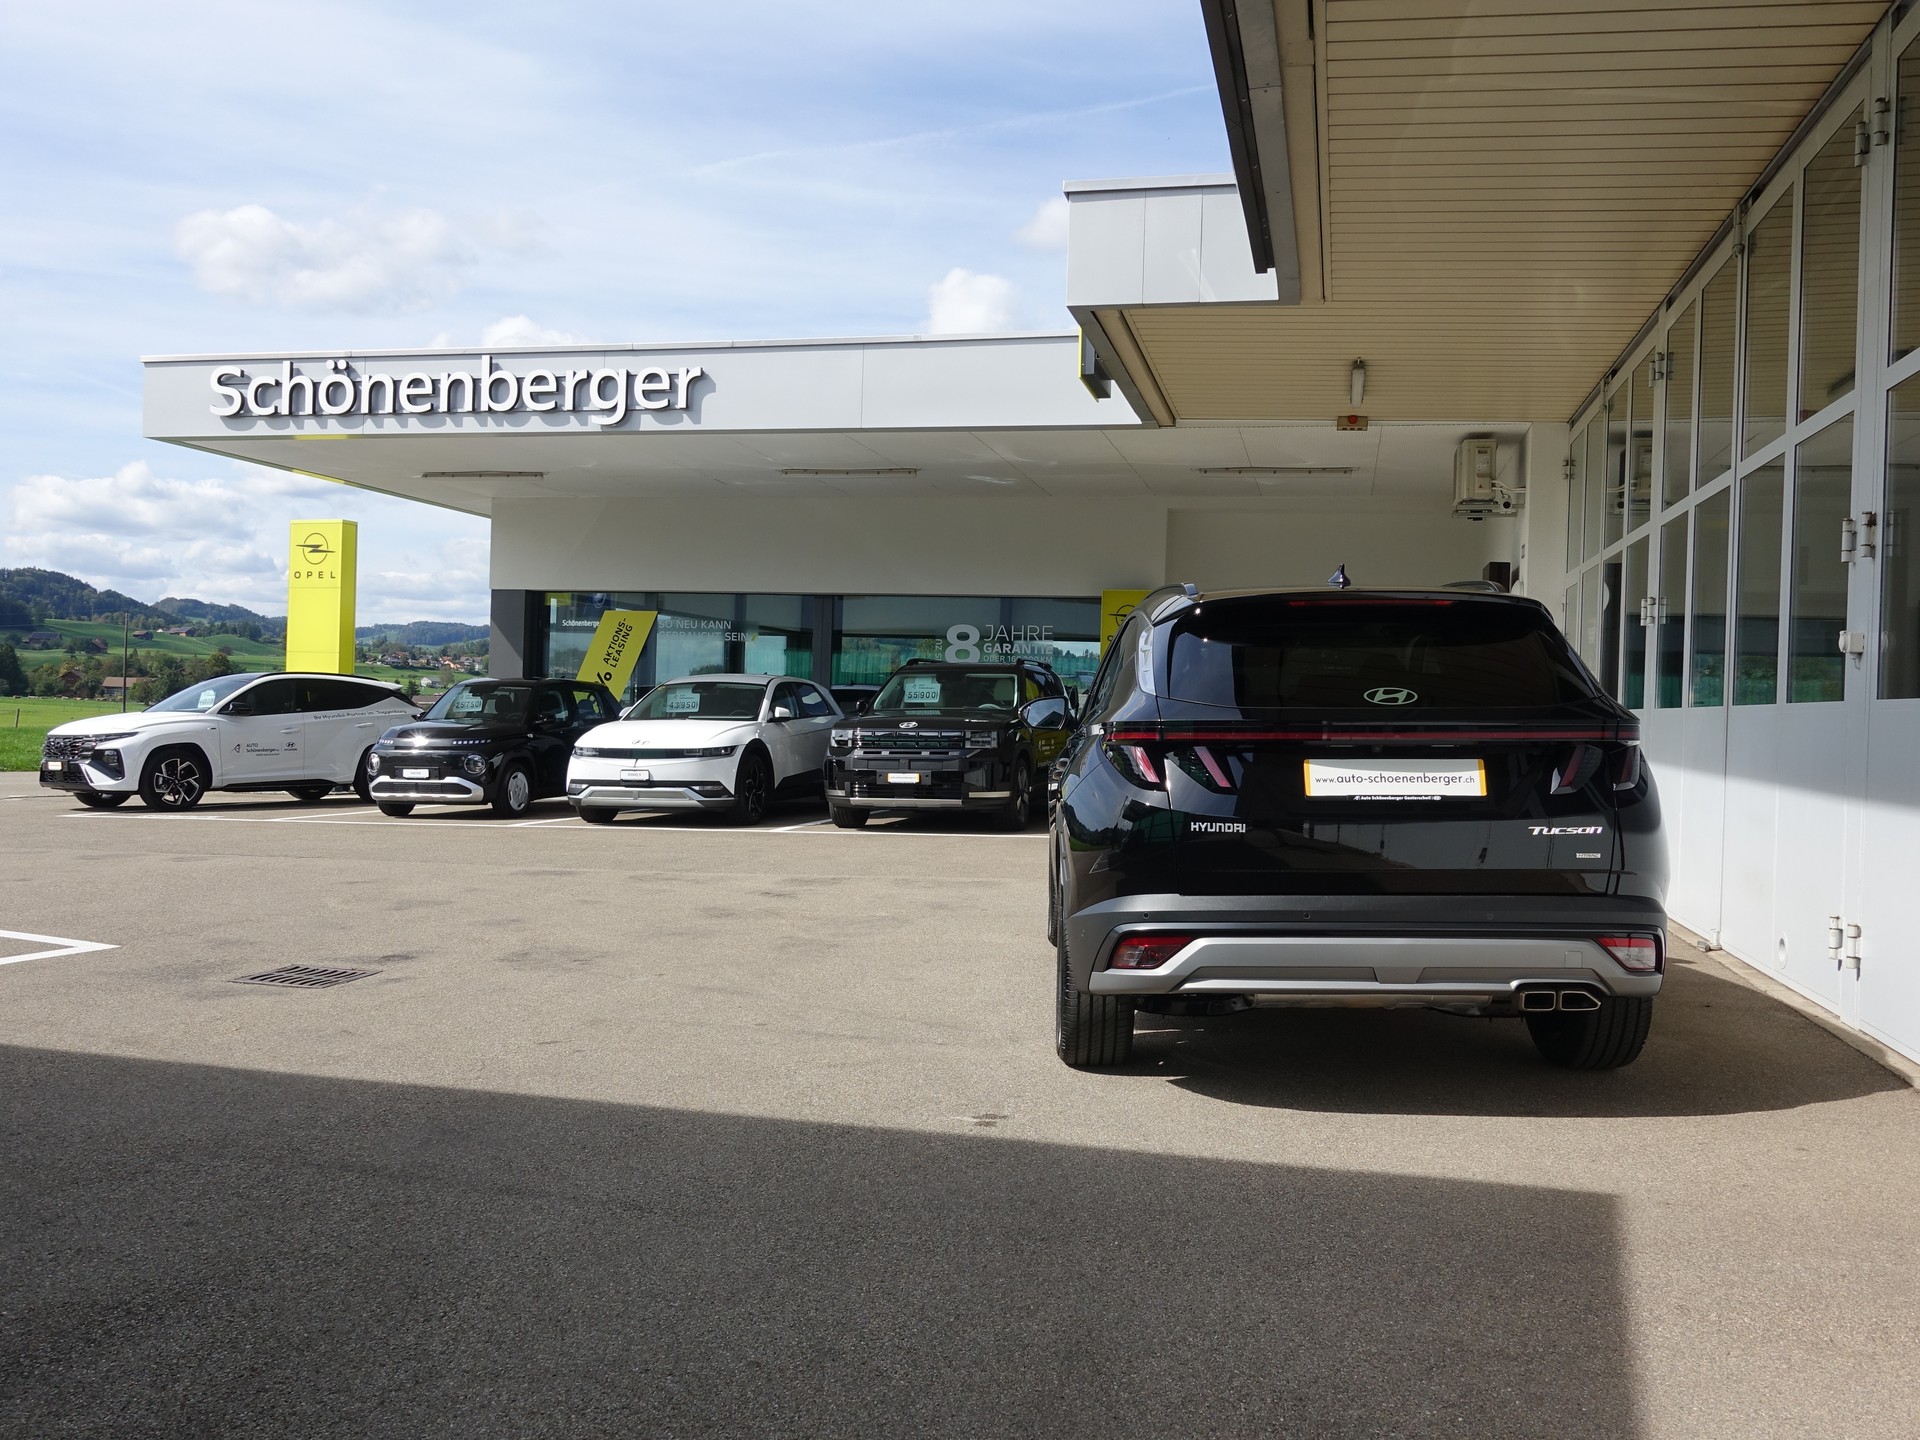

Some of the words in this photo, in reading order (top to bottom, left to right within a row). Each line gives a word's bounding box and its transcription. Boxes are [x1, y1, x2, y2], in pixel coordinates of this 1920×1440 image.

[209, 354, 703, 426] Schönenberger
[294, 571, 336, 579] OPEL
[562, 620, 600, 628] Schönenberge
[658, 620, 673, 629] SO
[676, 620, 698, 630] NEU
[701, 620, 731, 630] KANN
[724, 632, 749, 641] SEIN
[983, 624, 1054, 642] JAHRE
[603, 618, 626, 664] AKTIONS-
[609, 625, 633, 668] LEASING
[944, 624, 980, 663] 8
[983, 643, 1053, 655] GARANTIE
[1315, 772, 1475, 786] www.auto-schoenenberger.ch
[1190, 822, 1246, 833] HYUNDAI
